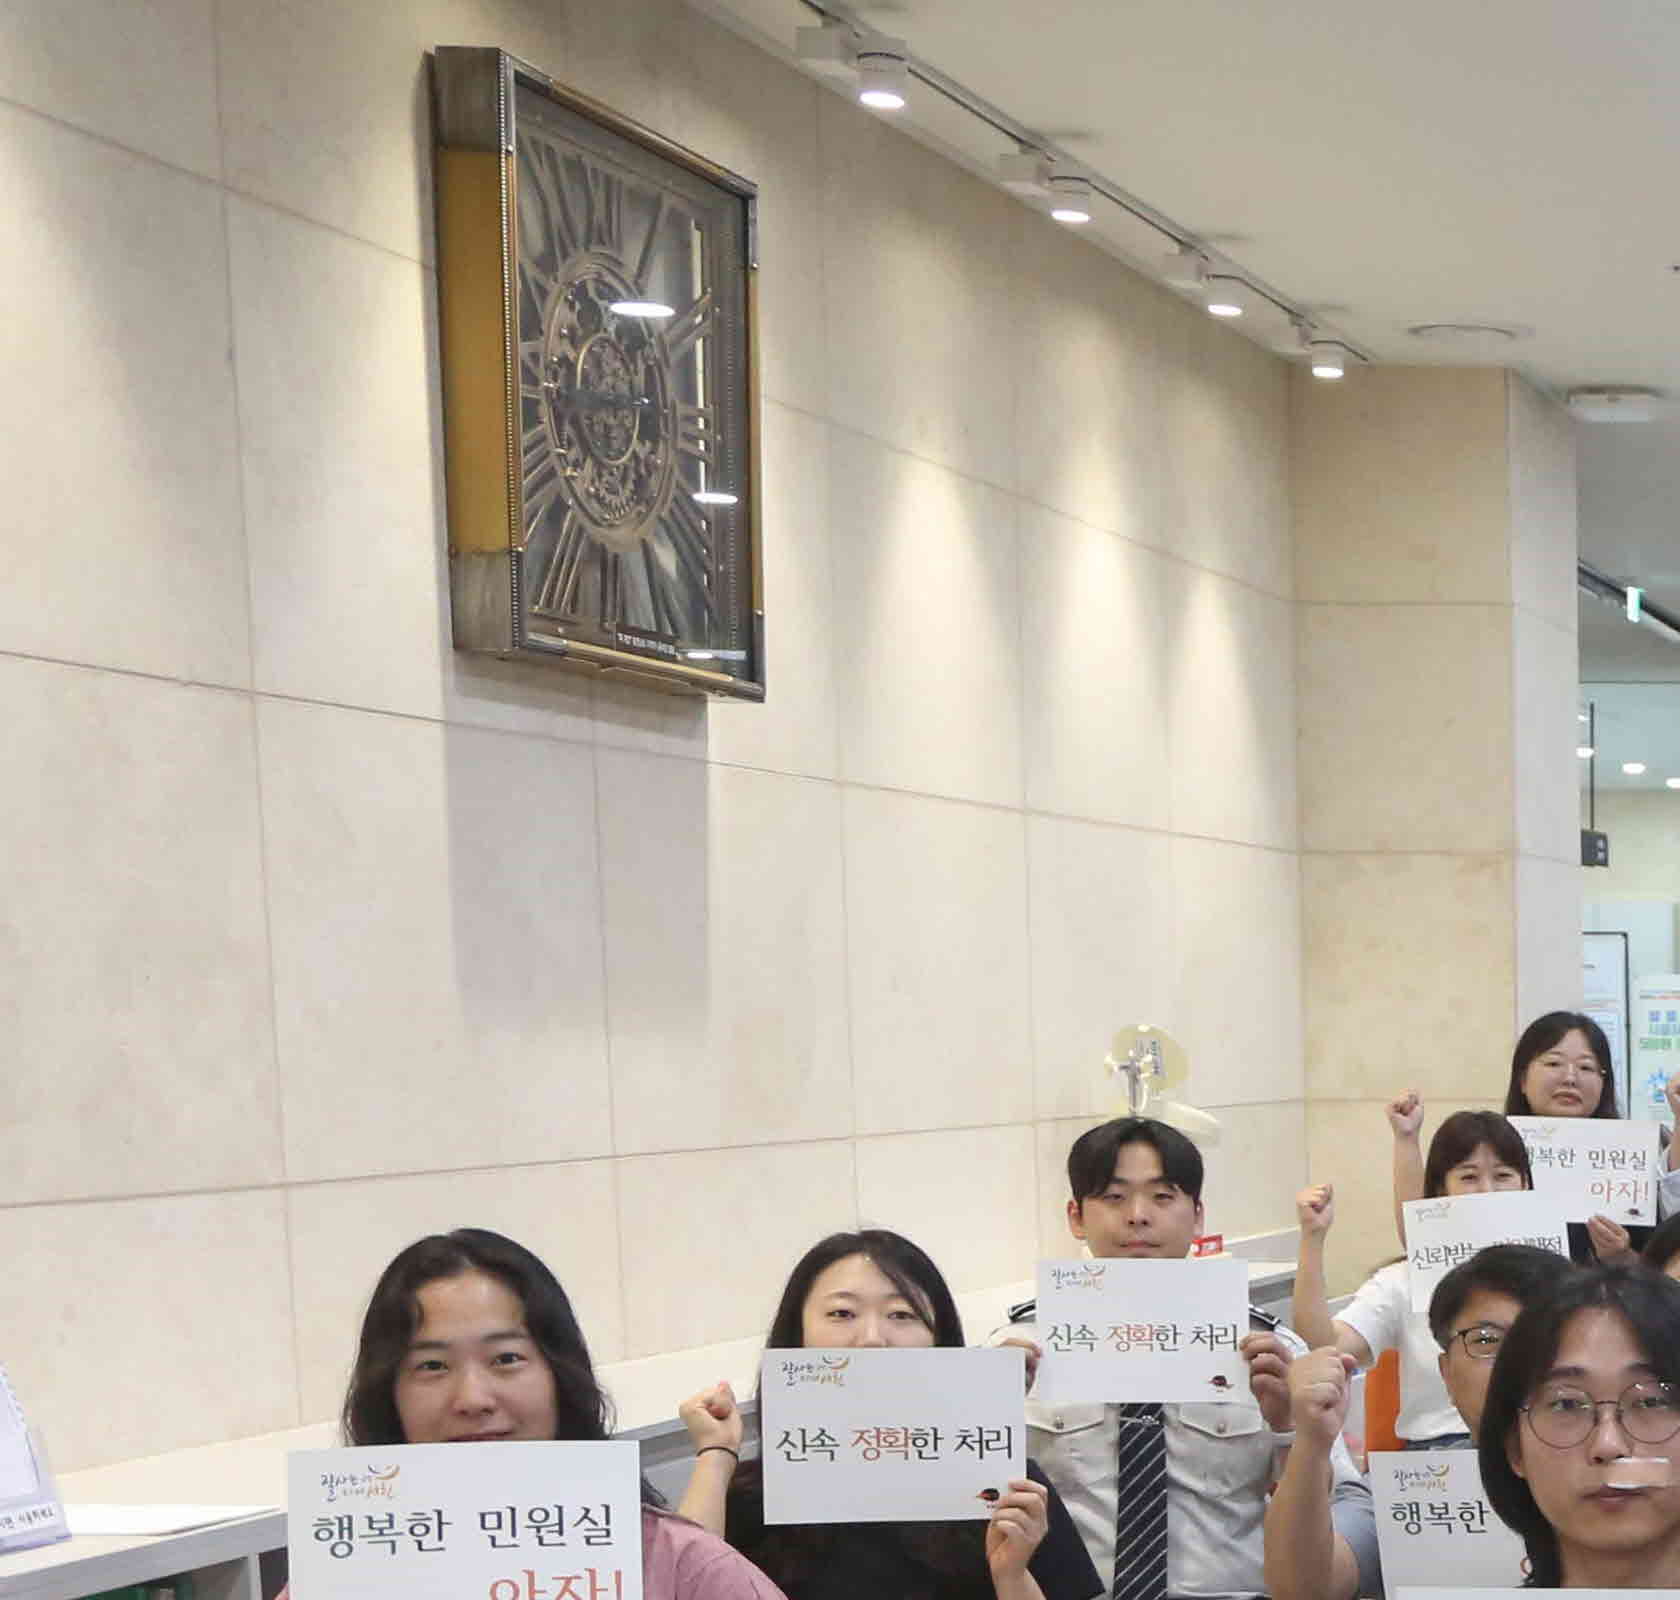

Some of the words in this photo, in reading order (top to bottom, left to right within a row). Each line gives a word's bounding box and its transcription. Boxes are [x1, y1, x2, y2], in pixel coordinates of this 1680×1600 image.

[1587, 1148, 1648, 1171] 민원실
[1589, 1179, 1650, 1204] 아자!
[1046, 1322, 1099, 1354] 신속
[1106, 1321, 1182, 1354] 정확한
[1190, 1322, 1239, 1354] 처리
[775, 1425, 841, 1464] 신속
[849, 1425, 945, 1463] 정확한
[954, 1424, 1014, 1462] 처리
[311, 1506, 454, 1562] 행복한
[478, 1501, 615, 1550] 민원실
[1389, 1499, 1491, 1536] 행복한
